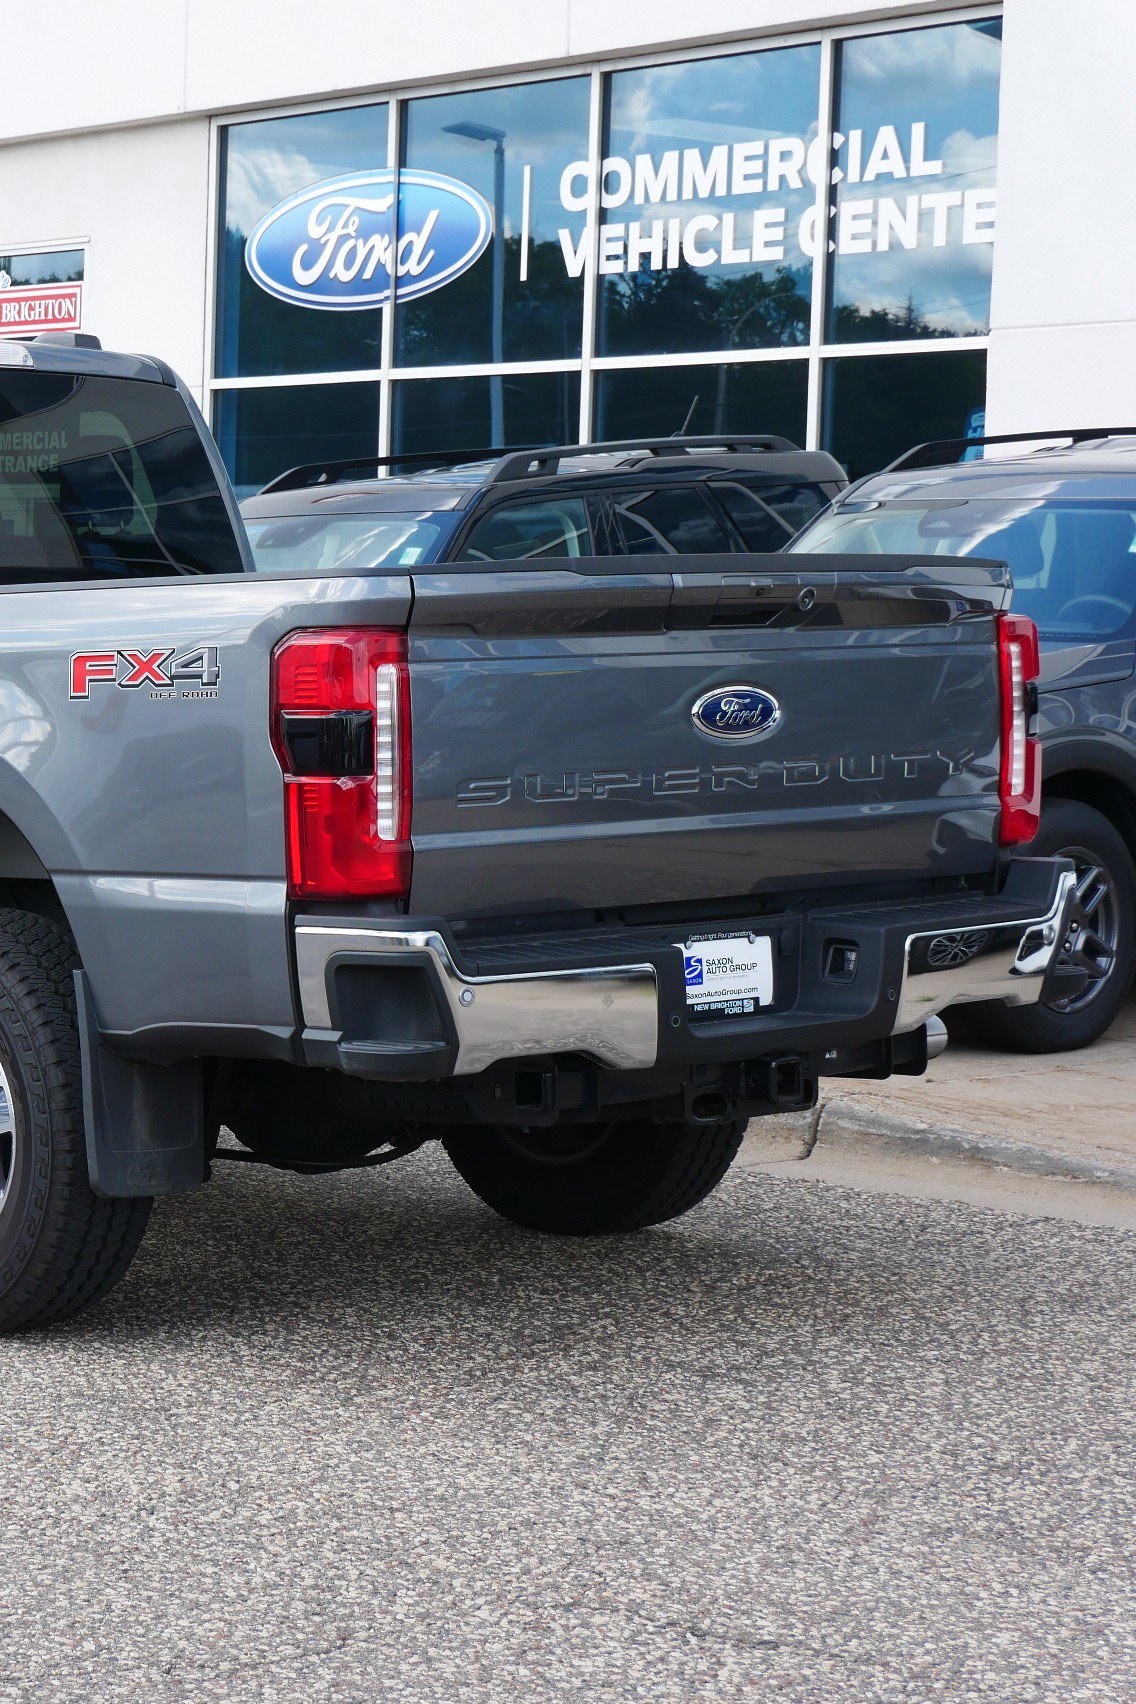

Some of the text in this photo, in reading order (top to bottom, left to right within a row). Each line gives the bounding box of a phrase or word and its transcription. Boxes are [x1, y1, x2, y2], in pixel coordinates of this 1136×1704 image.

[558, 121, 944, 213] COMMERCIAL
[292, 193, 440, 286] Ford
[558, 187, 998, 279] VEHICLE CENTE
[1, 298, 77, 323] BRIGHTON
[68, 645, 222, 701] FX4
[150, 690, 219, 699] OFF ROAD
[716, 697, 763, 726] Ford
[455, 747, 977, 809] SUPER DUTY
[705, 957, 733, 967] SAXON
[706, 963, 758, 975] AUTO GROUP
[694, 1000, 743, 1012] NEW BRIGHTON
[724, 1006, 743, 1015] FORD
